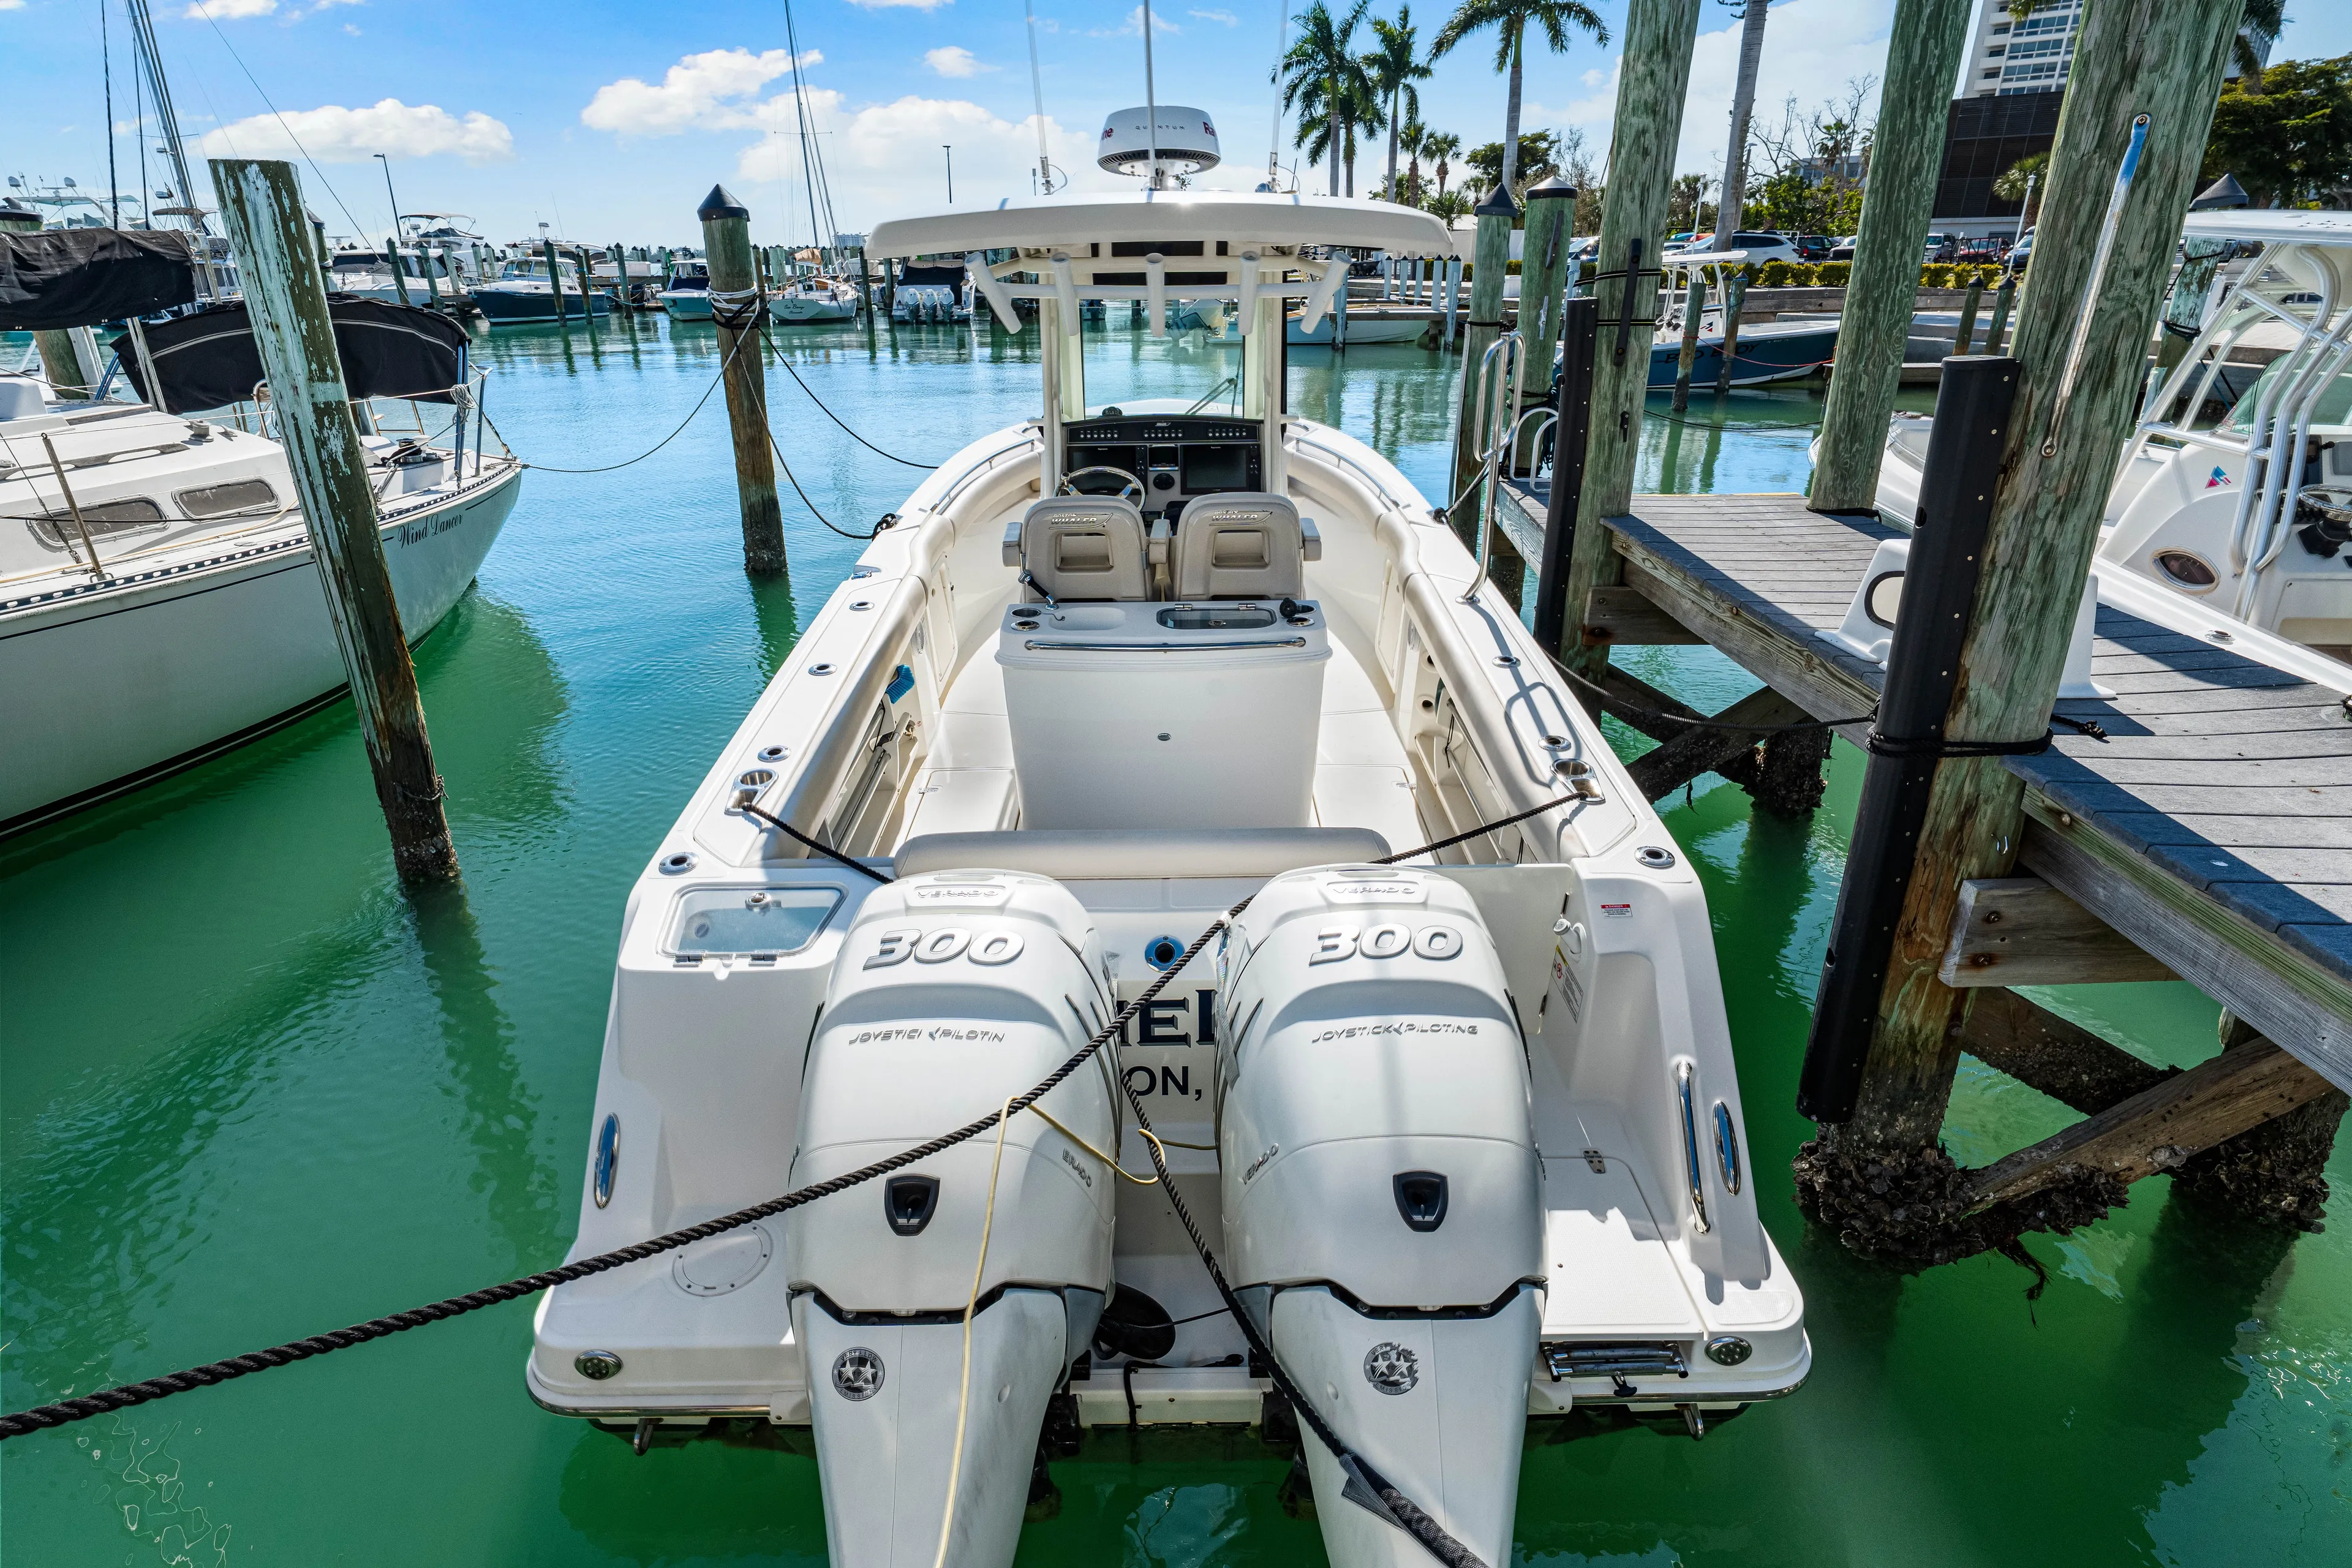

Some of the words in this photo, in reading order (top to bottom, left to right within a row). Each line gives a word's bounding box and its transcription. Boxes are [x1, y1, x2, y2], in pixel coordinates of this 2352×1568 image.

[398, 516, 428, 549] Wind
[431, 513, 464, 537] Dancer
[918, 890, 998, 899] VERADO
[862, 927, 1025, 971] 300
[1308, 923, 1463, 967] 300
[1311, 1023, 1393, 1044] JOYSTICK
[1404, 1022, 1478, 1036] PILOTING
[840, 1351, 858, 1362] VERY
[864, 1351, 878, 1362] LOW
